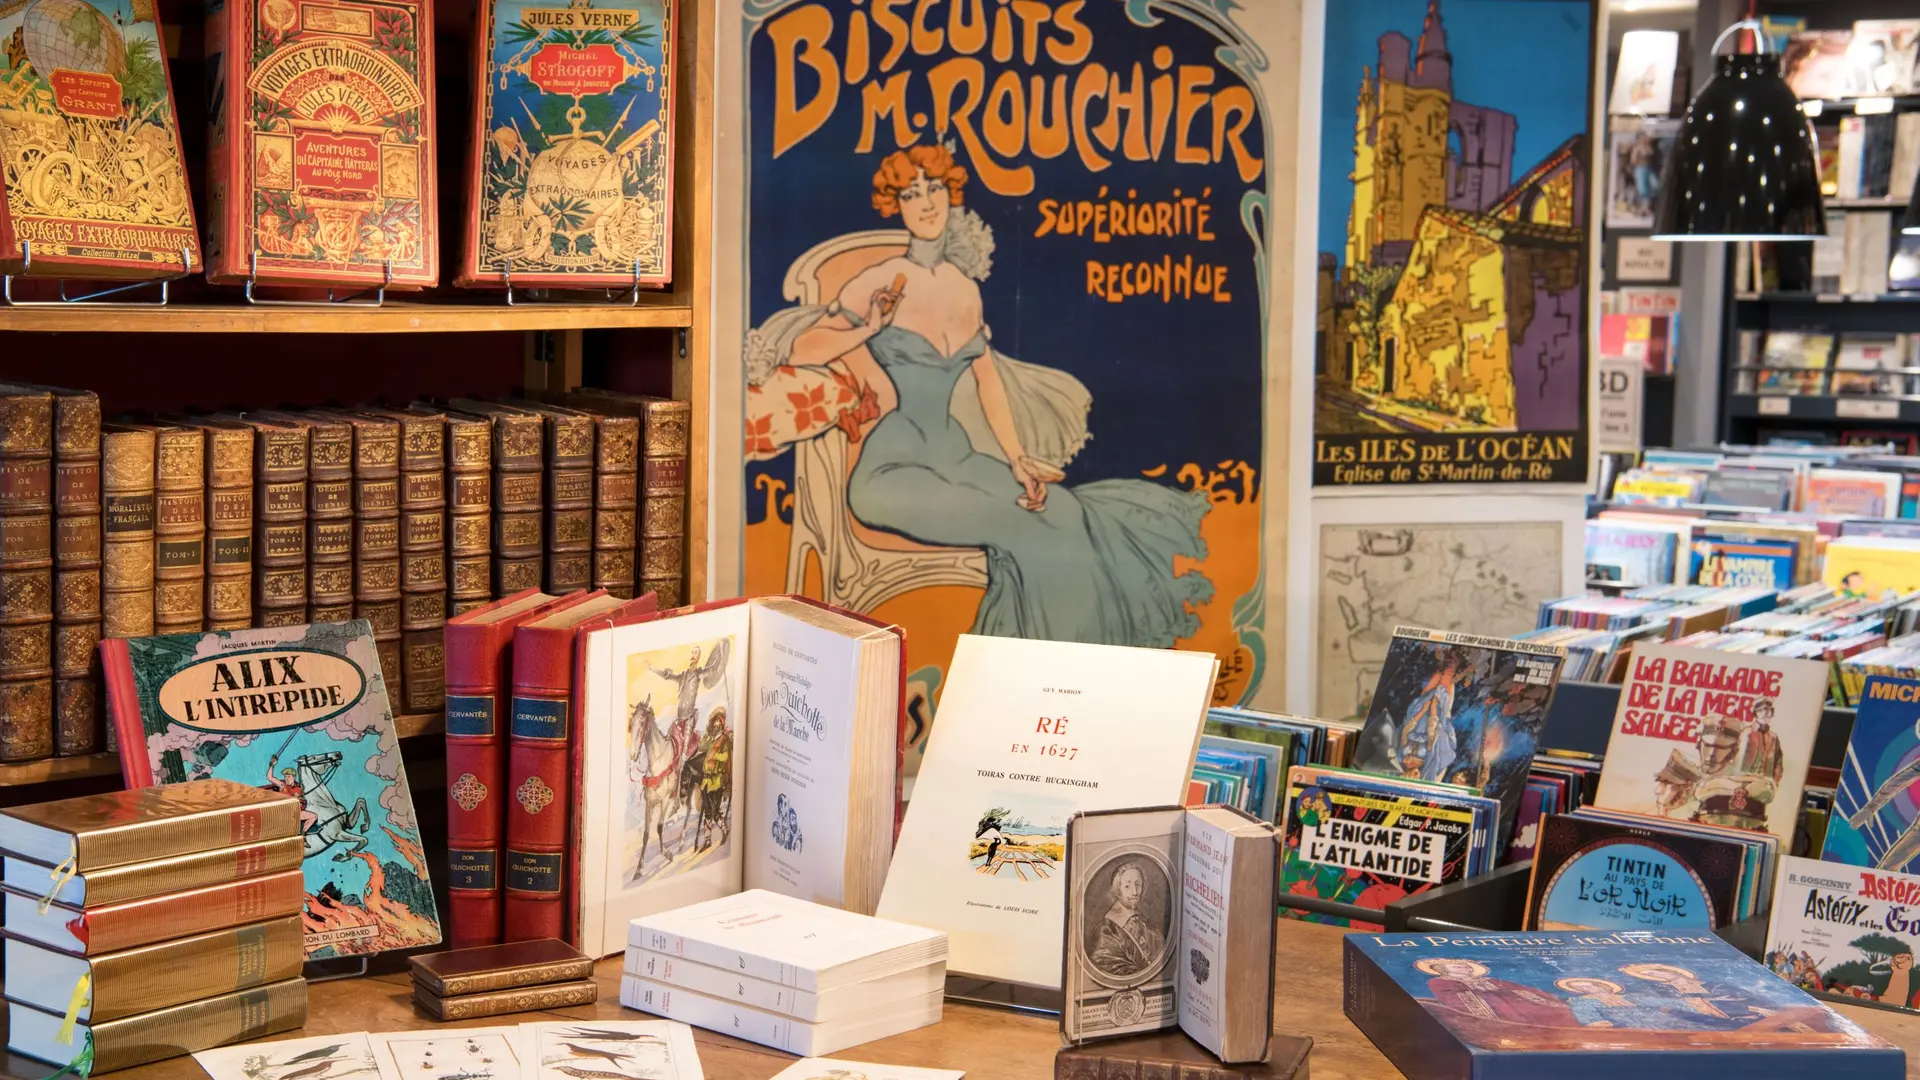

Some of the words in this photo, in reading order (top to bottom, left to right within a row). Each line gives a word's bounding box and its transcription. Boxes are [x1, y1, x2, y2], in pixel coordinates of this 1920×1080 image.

[528, 12, 574, 25] JULES
[580, 12, 633, 26] VERNE
[558, 50, 598, 60] MICHEL
[261, 52, 312, 94] VOYAGES
[312, 46, 411, 108] EXTRAORDINAIRES
[538, 61, 616, 78] STROGOFF
[767, 0, 1094, 160] BISCUITS
[62, 96, 117, 112] GRANT
[300, 86, 336, 117] JULES
[339, 86, 377, 121] VERNE
[926, 45, 1264, 197] ROUCHIER
[306, 141, 367, 157] AVENTURES
[548, 154, 606, 170] VOYAGES
[342, 170, 362, 180] NORD
[1034, 184, 1216, 244] SUPÉRIORITÉ
[12, 219, 75, 245] VOYAGES
[77, 225, 197, 253] EXTRAORDINAIRES
[81, 248, 116, 259] Collection
[117, 250, 140, 260] Hetzel
[1086, 254, 1233, 304] RECONNUE
[1628, 294, 1678, 310] TINTIN
[1360, 438, 1416, 462] ILES
[1457, 433, 1574, 462] L'OCÉAN
[1390, 463, 1412, 482] de
[220, 640, 249, 651] JACQUES
[250, 638, 277, 648] MARTIN
[1394, 626, 1430, 640] BOURGEON
[1445, 633, 1458, 644] LES
[1458, 635, 1506, 650] COMPAGNONS
[1506, 642, 1517, 651] DU
[211, 654, 307, 694] ALIX
[1634, 656, 1666, 684] LA
[1670, 658, 1784, 698] BALLADE
[1058, 688, 1084, 696] MARION
[183, 684, 345, 723] L'INTREPIDE
[780, 682, 828, 742] Quichotte
[1628, 683, 1662, 711] DE
[1664, 687, 1699, 714] LA
[1699, 691, 1757, 722] MER
[1035, 716, 1069, 736] RÉ
[1010, 743, 1031, 754] EN
[1040, 743, 1080, 761] 1627
[976, 769, 1005, 780] TOIRAS
[1008, 772, 1042, 783] CONTRE
[1045, 776, 1100, 790] BUCKINGHAM
[1297, 774, 1305, 783] 2
[1346, 797, 1383, 811] AVENTURES
[1400, 816, 1423, 830] Edgar
[1426, 821, 1434, 833] P.
[1434, 822, 1463, 836] Jacobs
[1316, 820, 1404, 853] L'ENIGME
[1407, 833, 1434, 857] DE
[450, 864, 490, 872] QUICHOTTE
[512, 864, 552, 874] QUICHOTTE
[1310, 841, 1433, 880] L'ATLANTIDE
[1606, 855, 1668, 880] TINTIN
[527, 877, 534, 885] 2
[1604, 872, 1618, 884] AU
[1622, 876, 1647, 889] PAYS
[1652, 879, 1666, 892] DE
[1788, 872, 1800, 882] R.
[1801, 874, 1853, 892] GOSCINNY
[1803, 888, 1869, 927] Astérix
[1860, 919, 1869, 928] et
[1870, 920, 1884, 932] les
[323, 932, 335, 942] DU
[336, 928, 371, 940] LOMBARD
[1372, 934, 1412, 948] La
[1424, 935, 1564, 949] Peinture
[1570, 932, 1717, 947] italienne
